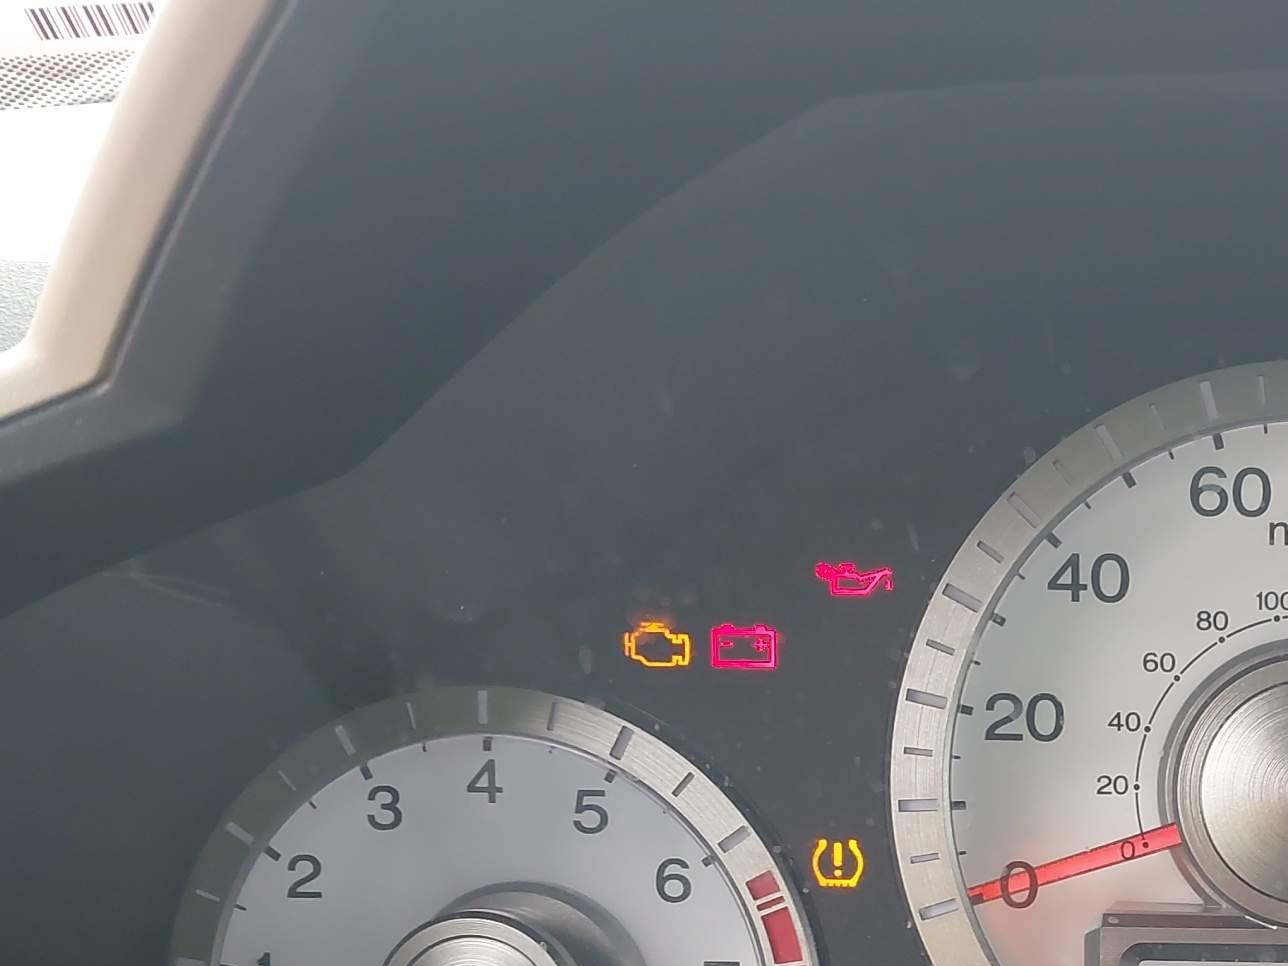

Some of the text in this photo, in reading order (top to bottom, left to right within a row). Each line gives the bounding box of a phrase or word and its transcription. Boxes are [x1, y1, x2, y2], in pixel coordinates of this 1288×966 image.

[1190, 467, 1271, 517] 60
[1048, 553, 1129, 603] 40
[1197, 611, 1228, 631] 80
[1143, 653, 1175, 672] 60
[985, 693, 1064, 742] 20
[1108, 712, 1140, 731] 40
[467, 759, 503, 803] 4
[1097, 775, 1128, 795] 20
[368, 786, 402, 830] 3
[573, 790, 608, 834] 5
[1120, 841, 1135, 860] 0
[288, 855, 322, 898] 2
[656, 859, 691, 903] 6
[1002, 861, 1038, 908] 0
